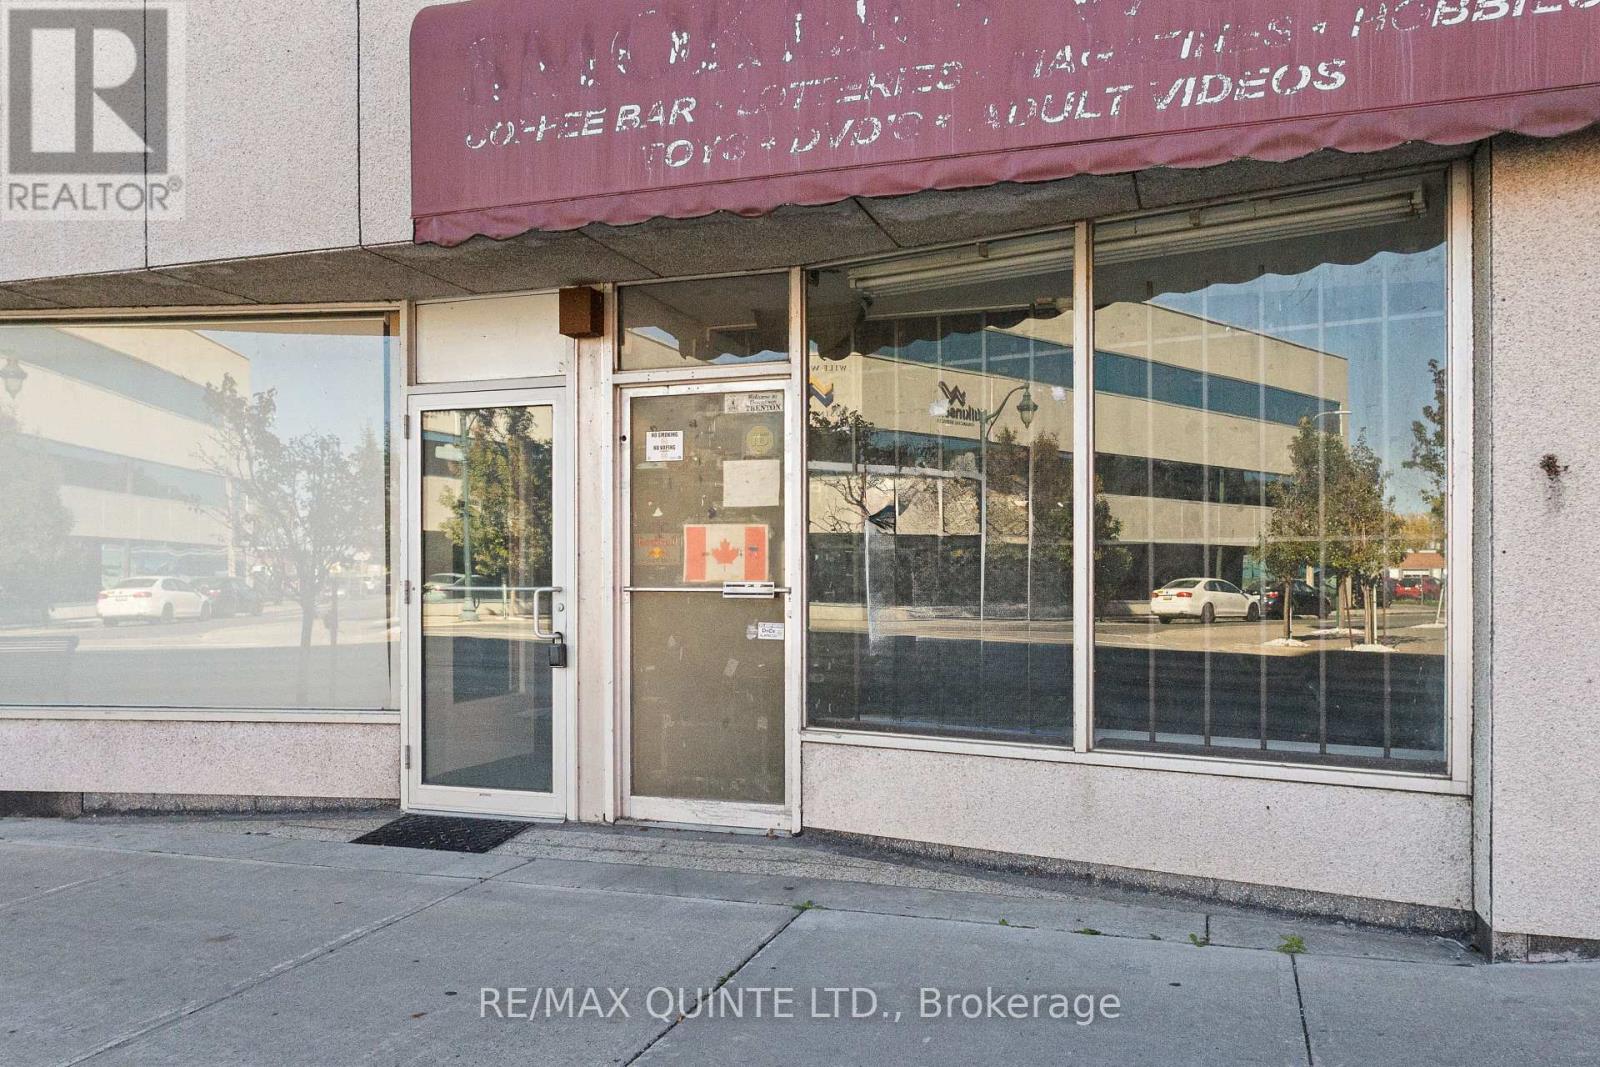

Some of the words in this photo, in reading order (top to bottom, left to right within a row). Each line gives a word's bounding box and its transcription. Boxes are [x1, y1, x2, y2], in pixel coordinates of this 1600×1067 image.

[1150, 59, 1346, 111] VIDEOS
[615, 97, 697, 132] BAR
[745, 403, 781, 412] TRENTON
